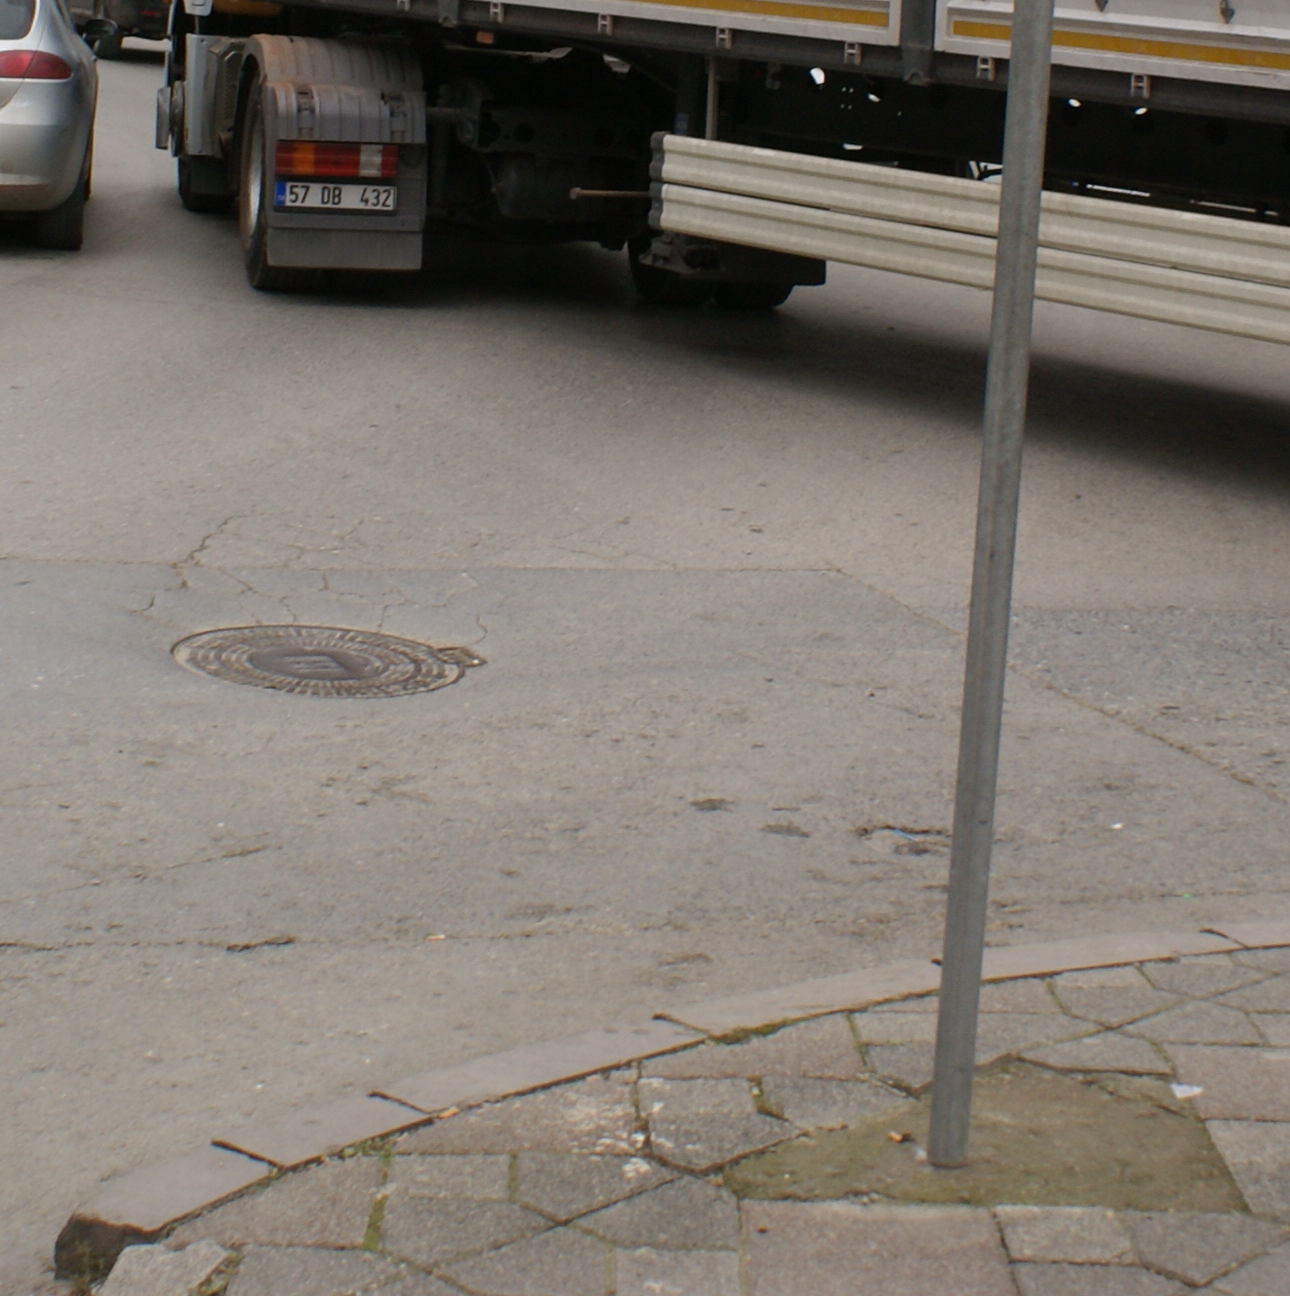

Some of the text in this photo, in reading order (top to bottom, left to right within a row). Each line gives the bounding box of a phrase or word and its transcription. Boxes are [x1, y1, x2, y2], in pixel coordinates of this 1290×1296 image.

[288, 184, 392, 208] 57 DB 432
